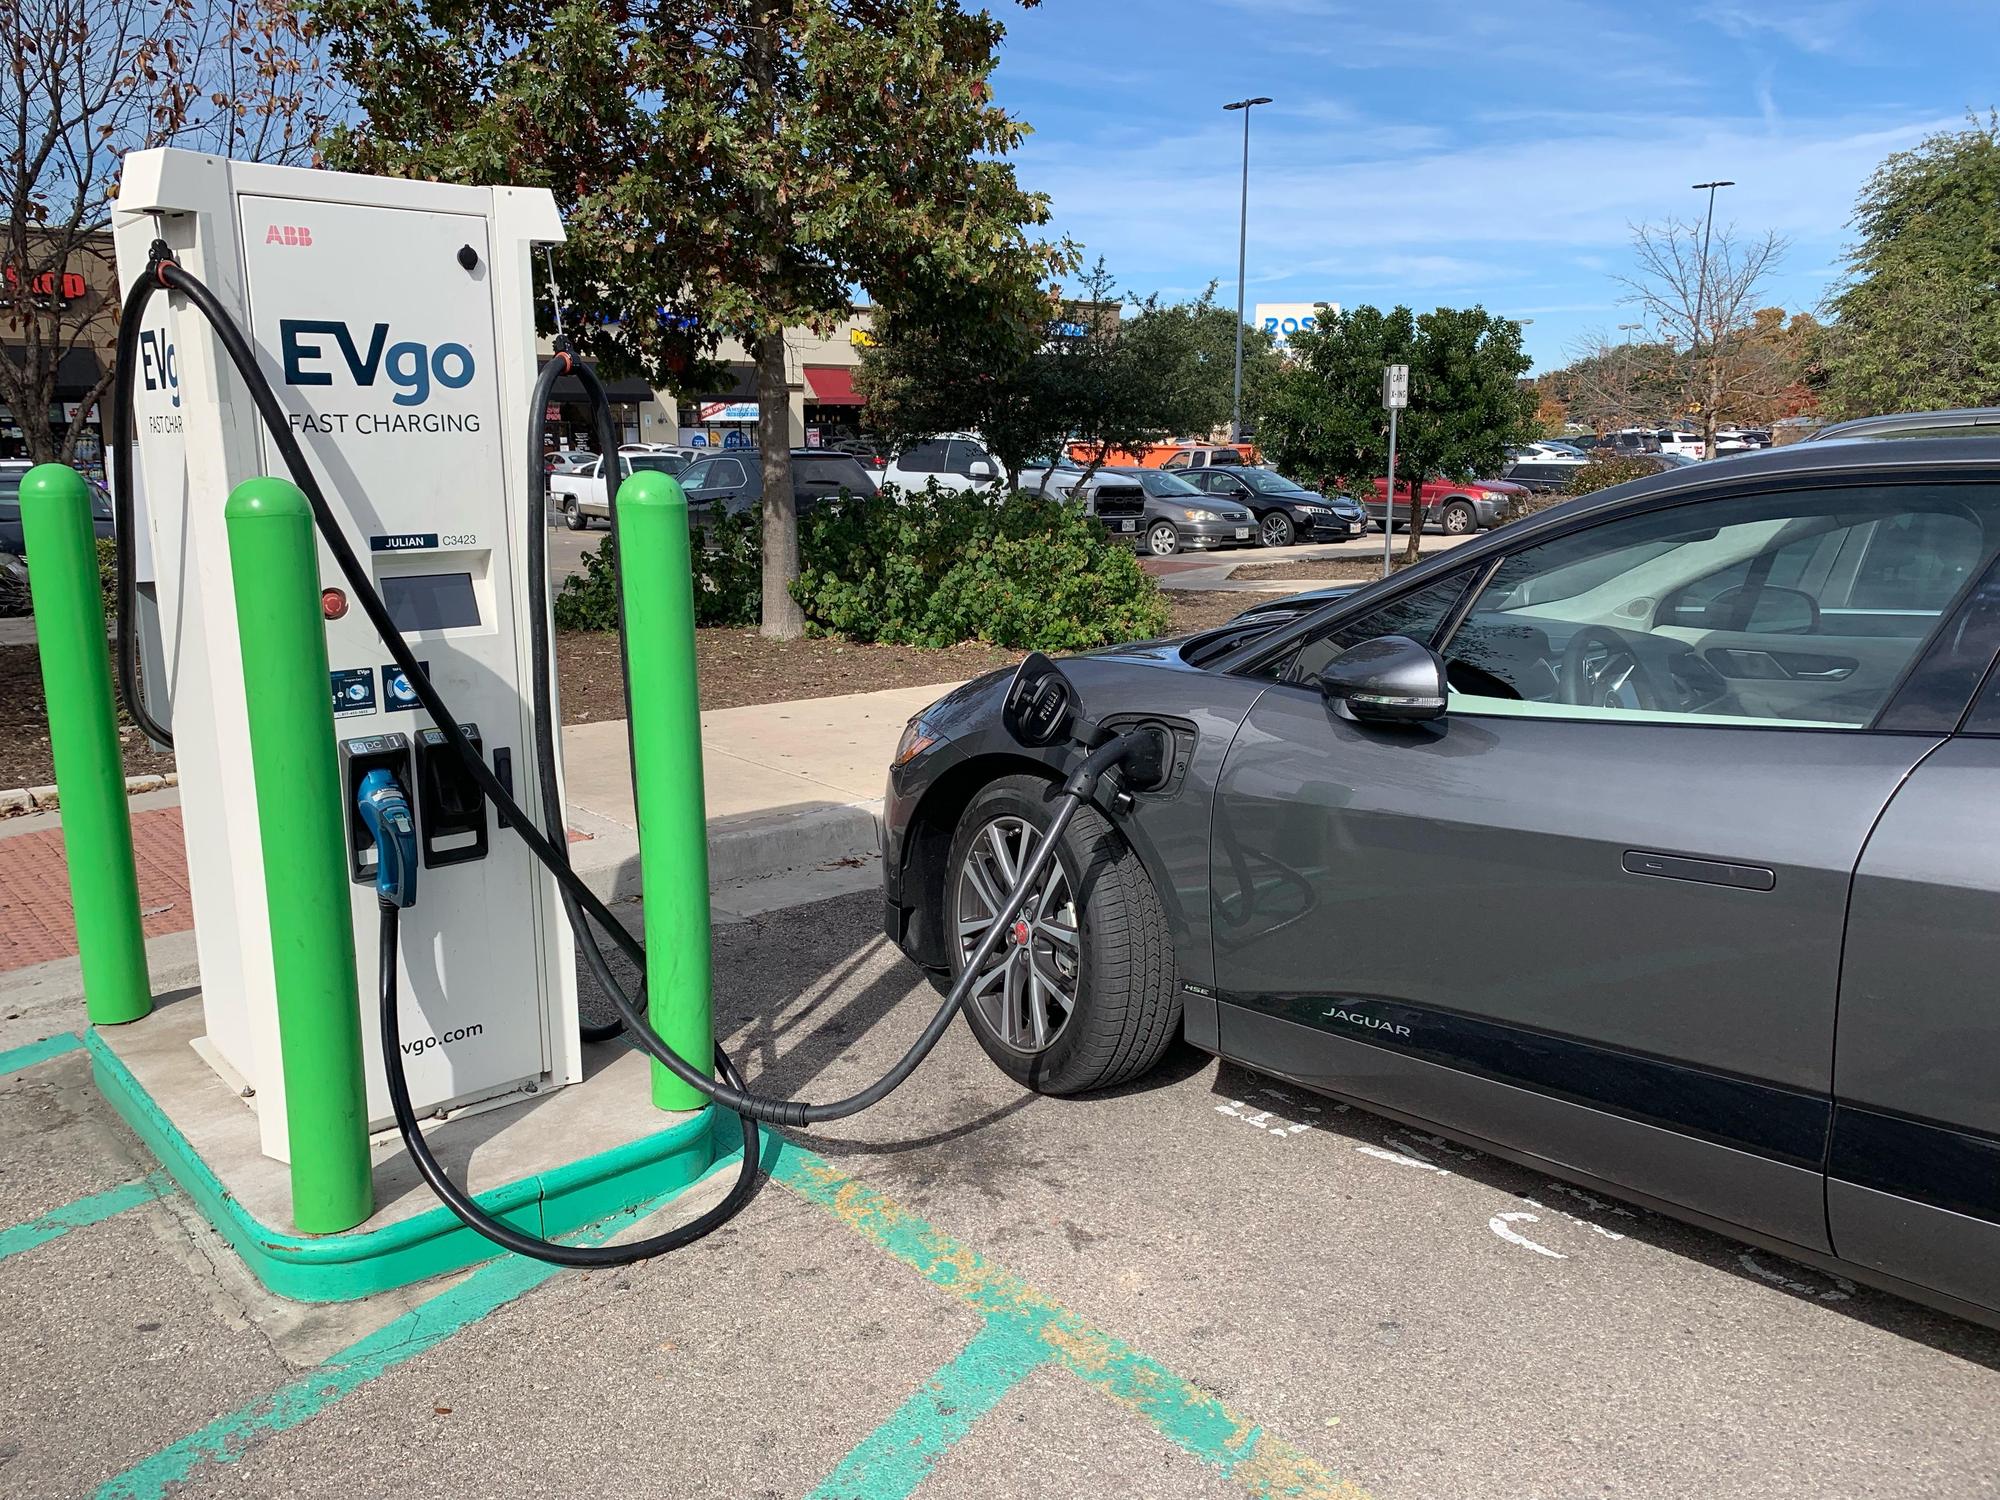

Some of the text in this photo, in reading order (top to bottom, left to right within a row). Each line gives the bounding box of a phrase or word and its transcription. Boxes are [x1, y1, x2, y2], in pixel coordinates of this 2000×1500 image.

[265, 224, 313, 247] ABB
[1264, 316, 1318, 337] ROS
[140, 327, 181, 408] EVg
[280, 319, 476, 407] EVgo
[1392, 374, 1406, 383] CART
[149, 415, 184, 434] FAST CHAR
[289, 413, 480, 435] FAST CHARGING
[1098, 496, 1144, 504] FORD
[385, 534, 477, 548] JULIAN C3423
[461, 726, 474, 738] 2
[366, 741, 382, 750] DC
[389, 736, 399, 748] 1
[1185, 984, 1210, 995] HSE
[1322, 1007, 1411, 1038] JAGUAR
[401, 1023, 483, 1056] vgo.com
